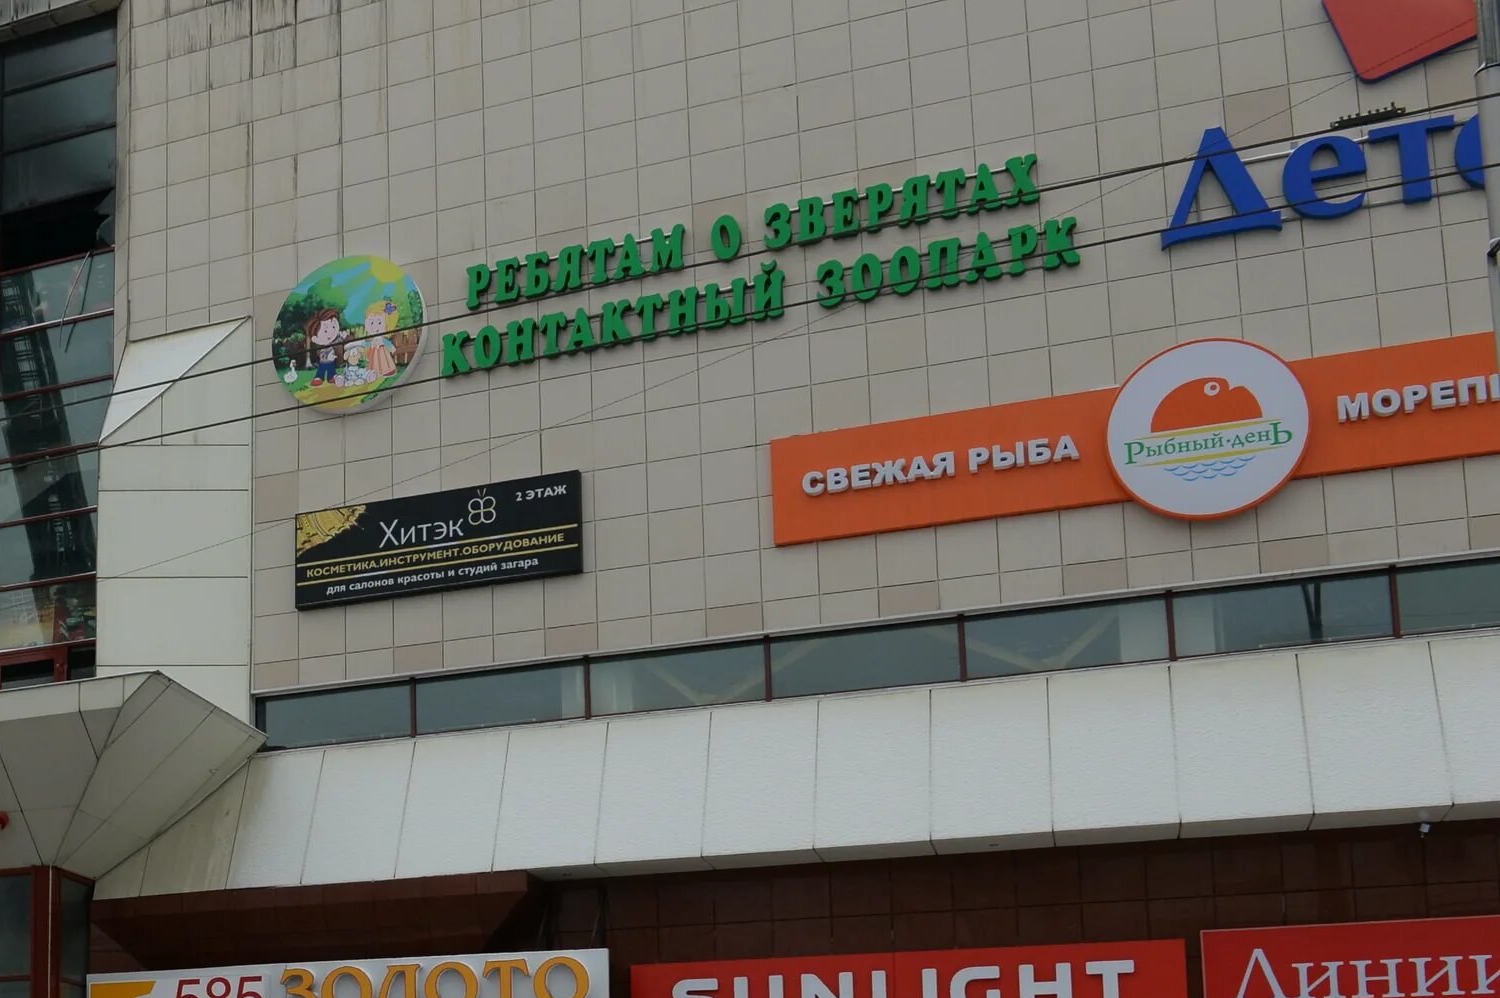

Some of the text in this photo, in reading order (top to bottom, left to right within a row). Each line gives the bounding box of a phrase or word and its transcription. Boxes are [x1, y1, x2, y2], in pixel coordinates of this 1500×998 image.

[466, 153, 1041, 310] РЕБЯТАМ О ЗВЕРЯТАХ
[442, 216, 1081, 378] КОНТАКТНЫЙ ЗООПАРК
[802, 435, 1080, 496] СВЕЖАЯ РЫБА
[515, 484, 568, 502] 2 ЭТАЖ
[379, 518, 464, 549] Хитэк
[326, 557, 539, 595] для салонов красоты и студий загара
